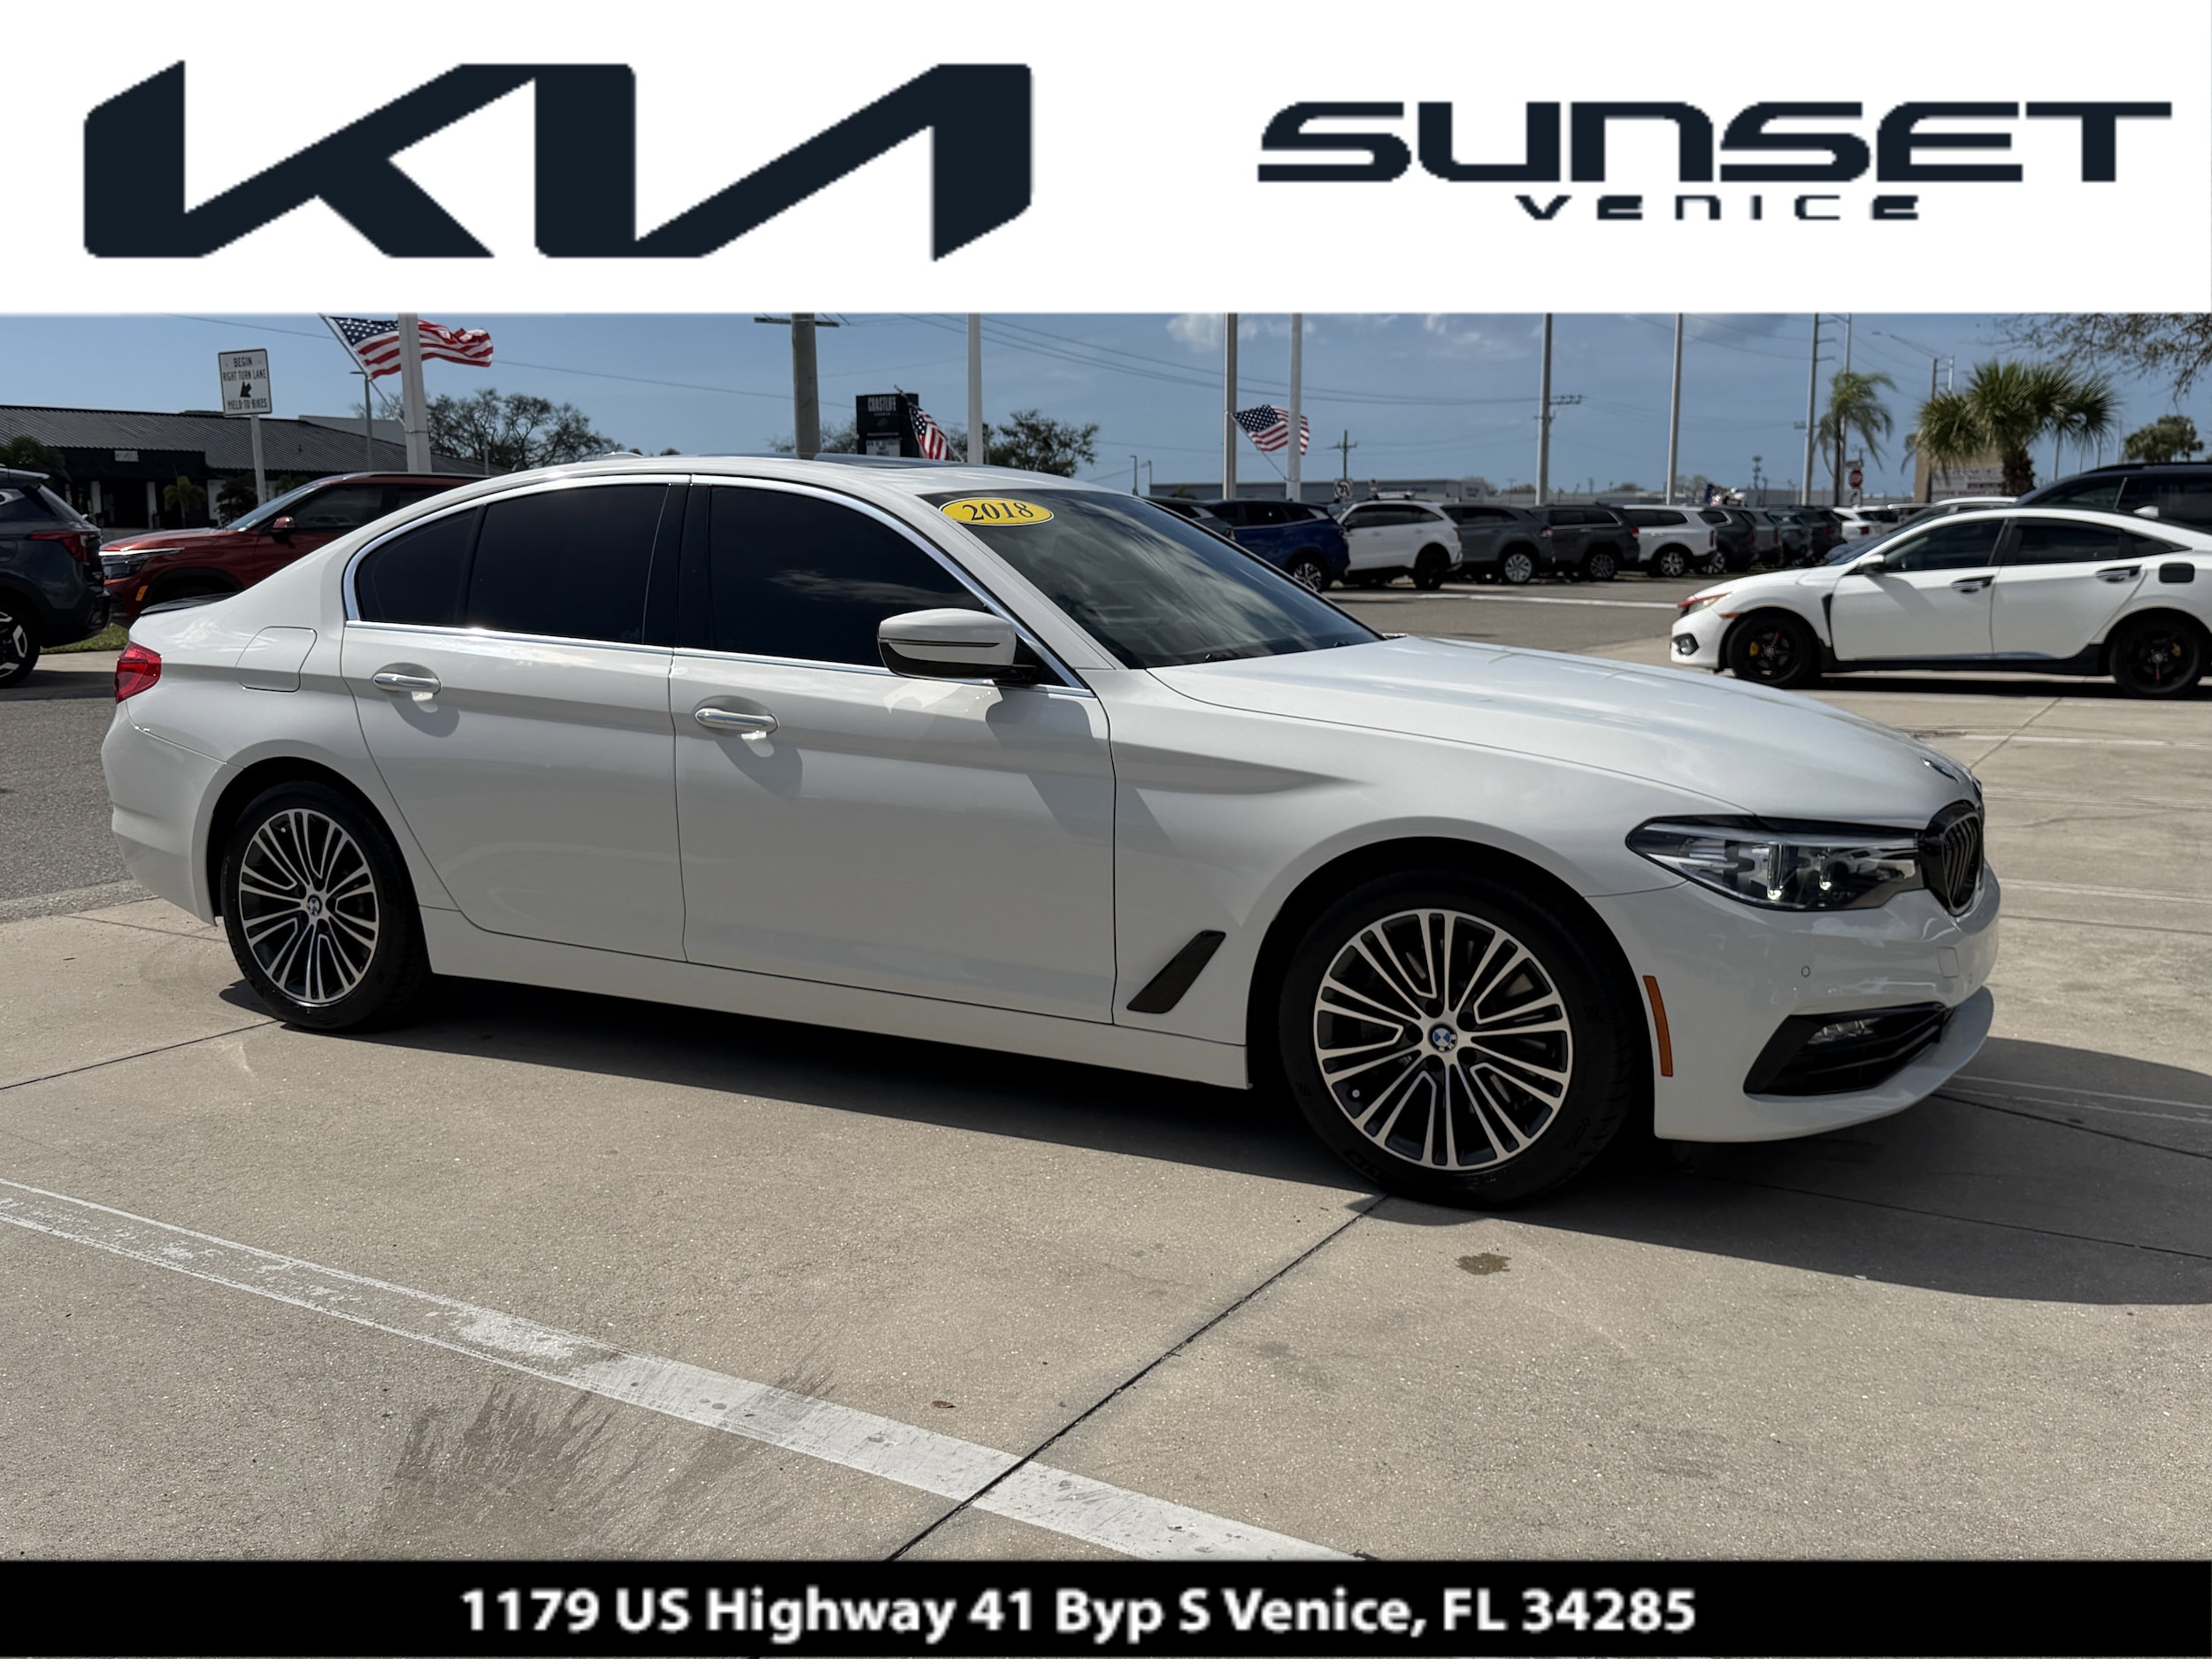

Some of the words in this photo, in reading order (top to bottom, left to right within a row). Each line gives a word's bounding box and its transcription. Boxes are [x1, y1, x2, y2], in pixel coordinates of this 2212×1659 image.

[234, 357, 252, 367] BEGIN
[223, 372, 237, 381] RIGHT
[238, 371, 251, 380] TURN
[253, 369, 266, 380] LANE
[227, 399, 242, 410] YIELD
[243, 398, 250, 408] TO
[251, 397, 267, 408] BIKES
[962, 502, 1033, 521] 2018
